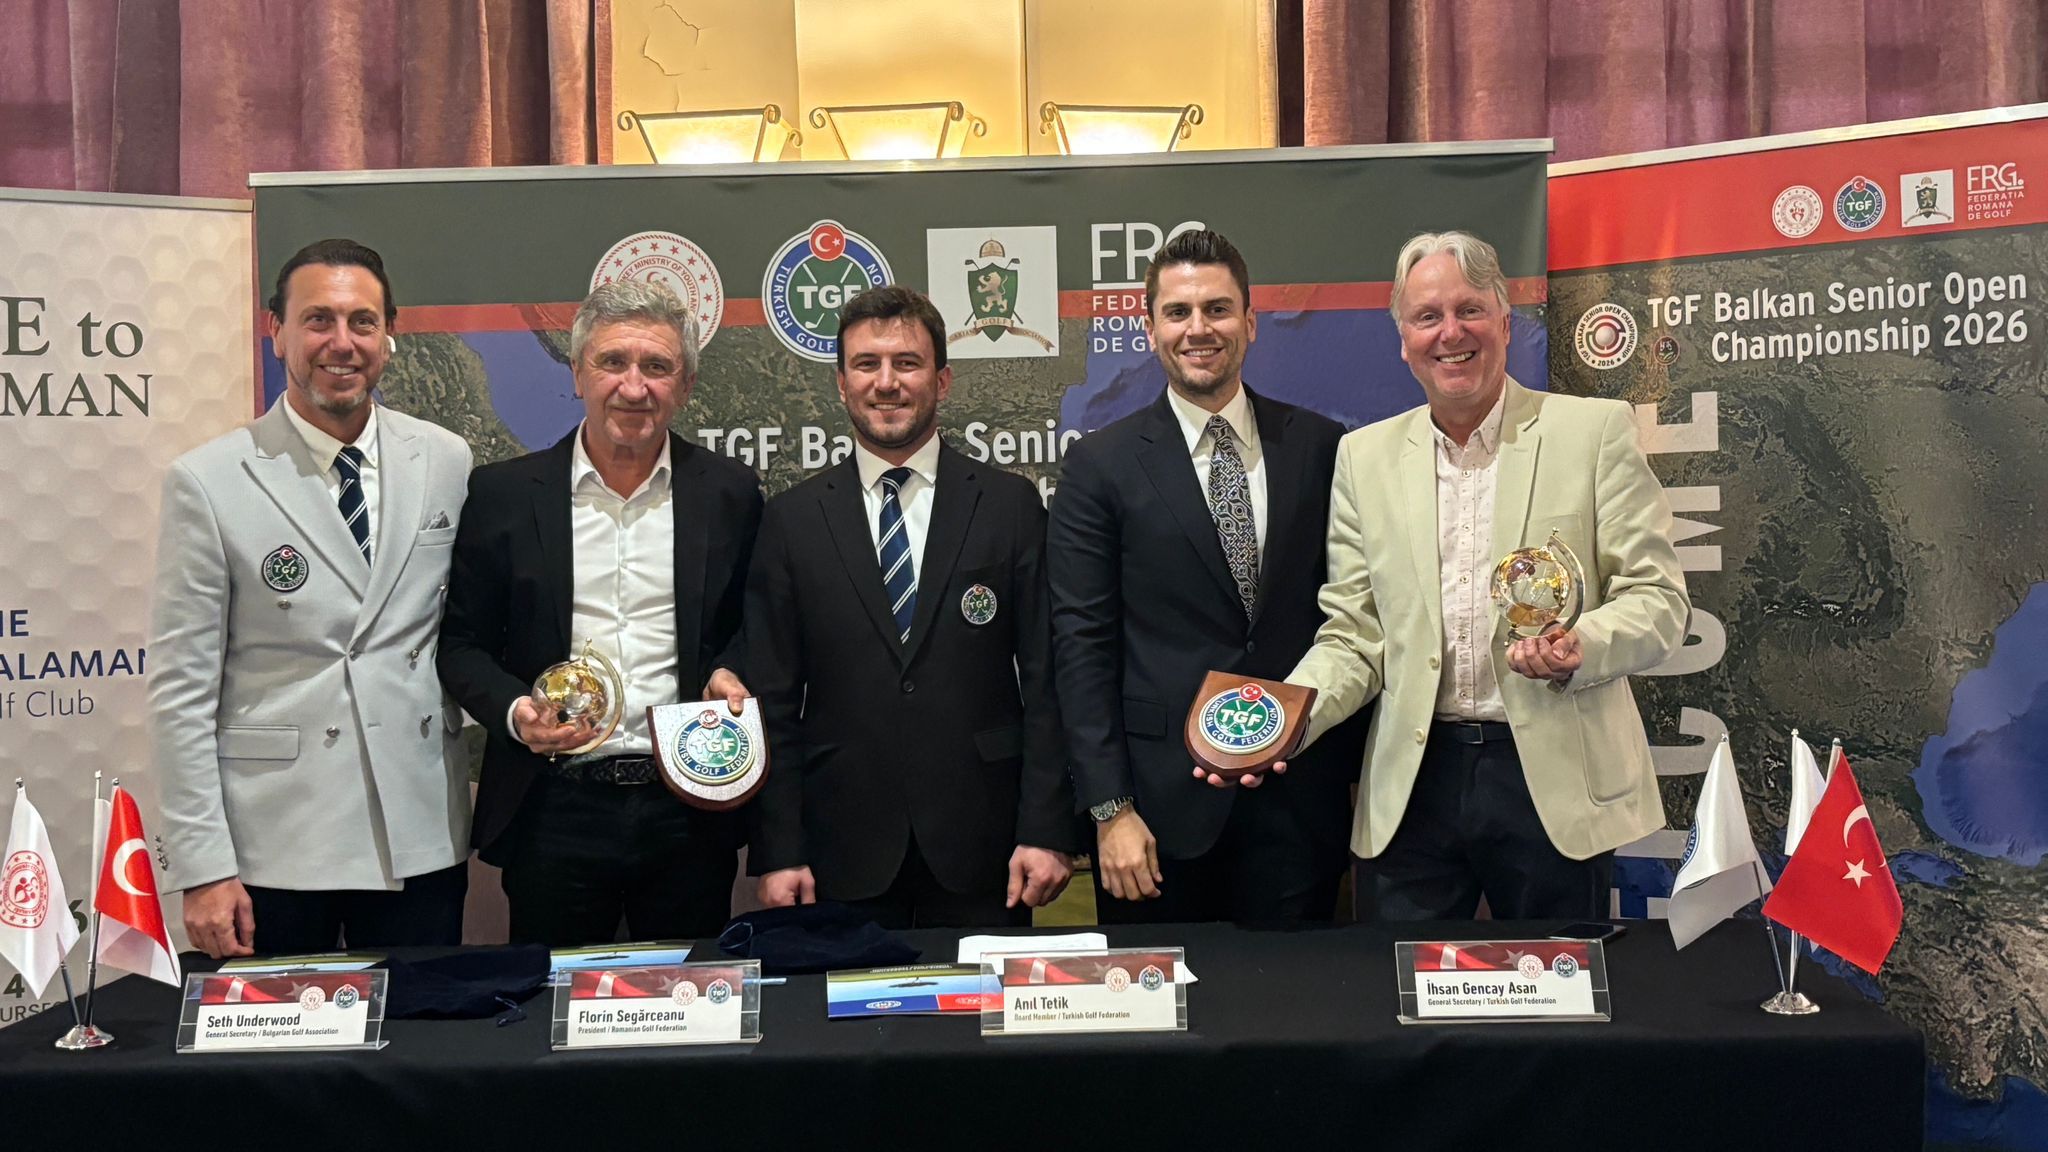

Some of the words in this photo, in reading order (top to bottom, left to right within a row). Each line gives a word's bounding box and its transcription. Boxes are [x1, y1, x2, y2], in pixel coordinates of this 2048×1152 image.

[1967, 191, 2025, 203] FEDERATIA
[1846, 200, 1873, 212] TGF
[1968, 201, 2014, 212] ROMANA
[1968, 212, 1981, 221] DE
[1984, 209, 2011, 219] GOLF
[633, 257, 671, 270] MINISTRY
[671, 262, 683, 272] OF
[681, 268, 697, 297] YOUTH
[796, 284, 862, 309] TGF
[1648, 294, 1701, 328] TGF
[1714, 287, 1815, 323] Balkan
[1827, 276, 1932, 314] Senior
[1944, 271, 2027, 311] Open
[773, 265, 793, 330] TURKISH
[796, 332, 834, 352] GOLF
[981, 317, 1008, 325] GOLF
[77, 312, 143, 357] to
[1583, 306, 1603, 323] SENIOR
[1604, 305, 1622, 316] OPEN
[1620, 312, 1636, 359] CHAMPIONSHIP
[1711, 317, 1931, 364] Championship
[1943, 309, 2028, 347] 2026
[1094, 337, 1123, 353] DE
[1597, 359, 1615, 367] 2026
[698, 427, 782, 470] TGF
[274, 565, 297, 575] TGF
[969, 598, 989, 610] TGF
[0, 609, 29, 637] E
[26, 689, 94, 718] Club
[1205, 697, 1229, 727] TURKISH
[1220, 708, 1263, 727] TGF
[1241, 707, 1278, 745] FEDERATION
[1212, 730, 1236, 744] GOLF
[689, 737, 736, 755] TGF
[694, 764, 721, 776] GOLF
[726, 727, 750, 773] FEDERATION
[3, 973, 25, 998] 4
[1427, 979, 1459, 995] İhsan
[1463, 982, 1505, 996] Gencay
[1509, 981, 1537, 994] Asan
[1040, 996, 1069, 1009] Tetik
[1428, 998, 1452, 1006] General
[1453, 998, 1482, 1007] Secretary
[1486, 997, 1510, 1005] Turkish
[1510, 997, 1524, 1005] Golf
[1524, 997, 1557, 1005] Federation
[207, 1015, 233, 1028] Seth
[236, 1013, 301, 1027] Underwood
[579, 1010, 613, 1024] Florin
[617, 1009, 685, 1025] Segărceanu
[229, 1030, 257, 1038] Secretary
[262, 1029, 291, 1037] Bulgarian
[291, 1028, 304, 1036] Golf
[578, 1026, 607, 1034] President
[655, 1024, 688, 1032] Federation
